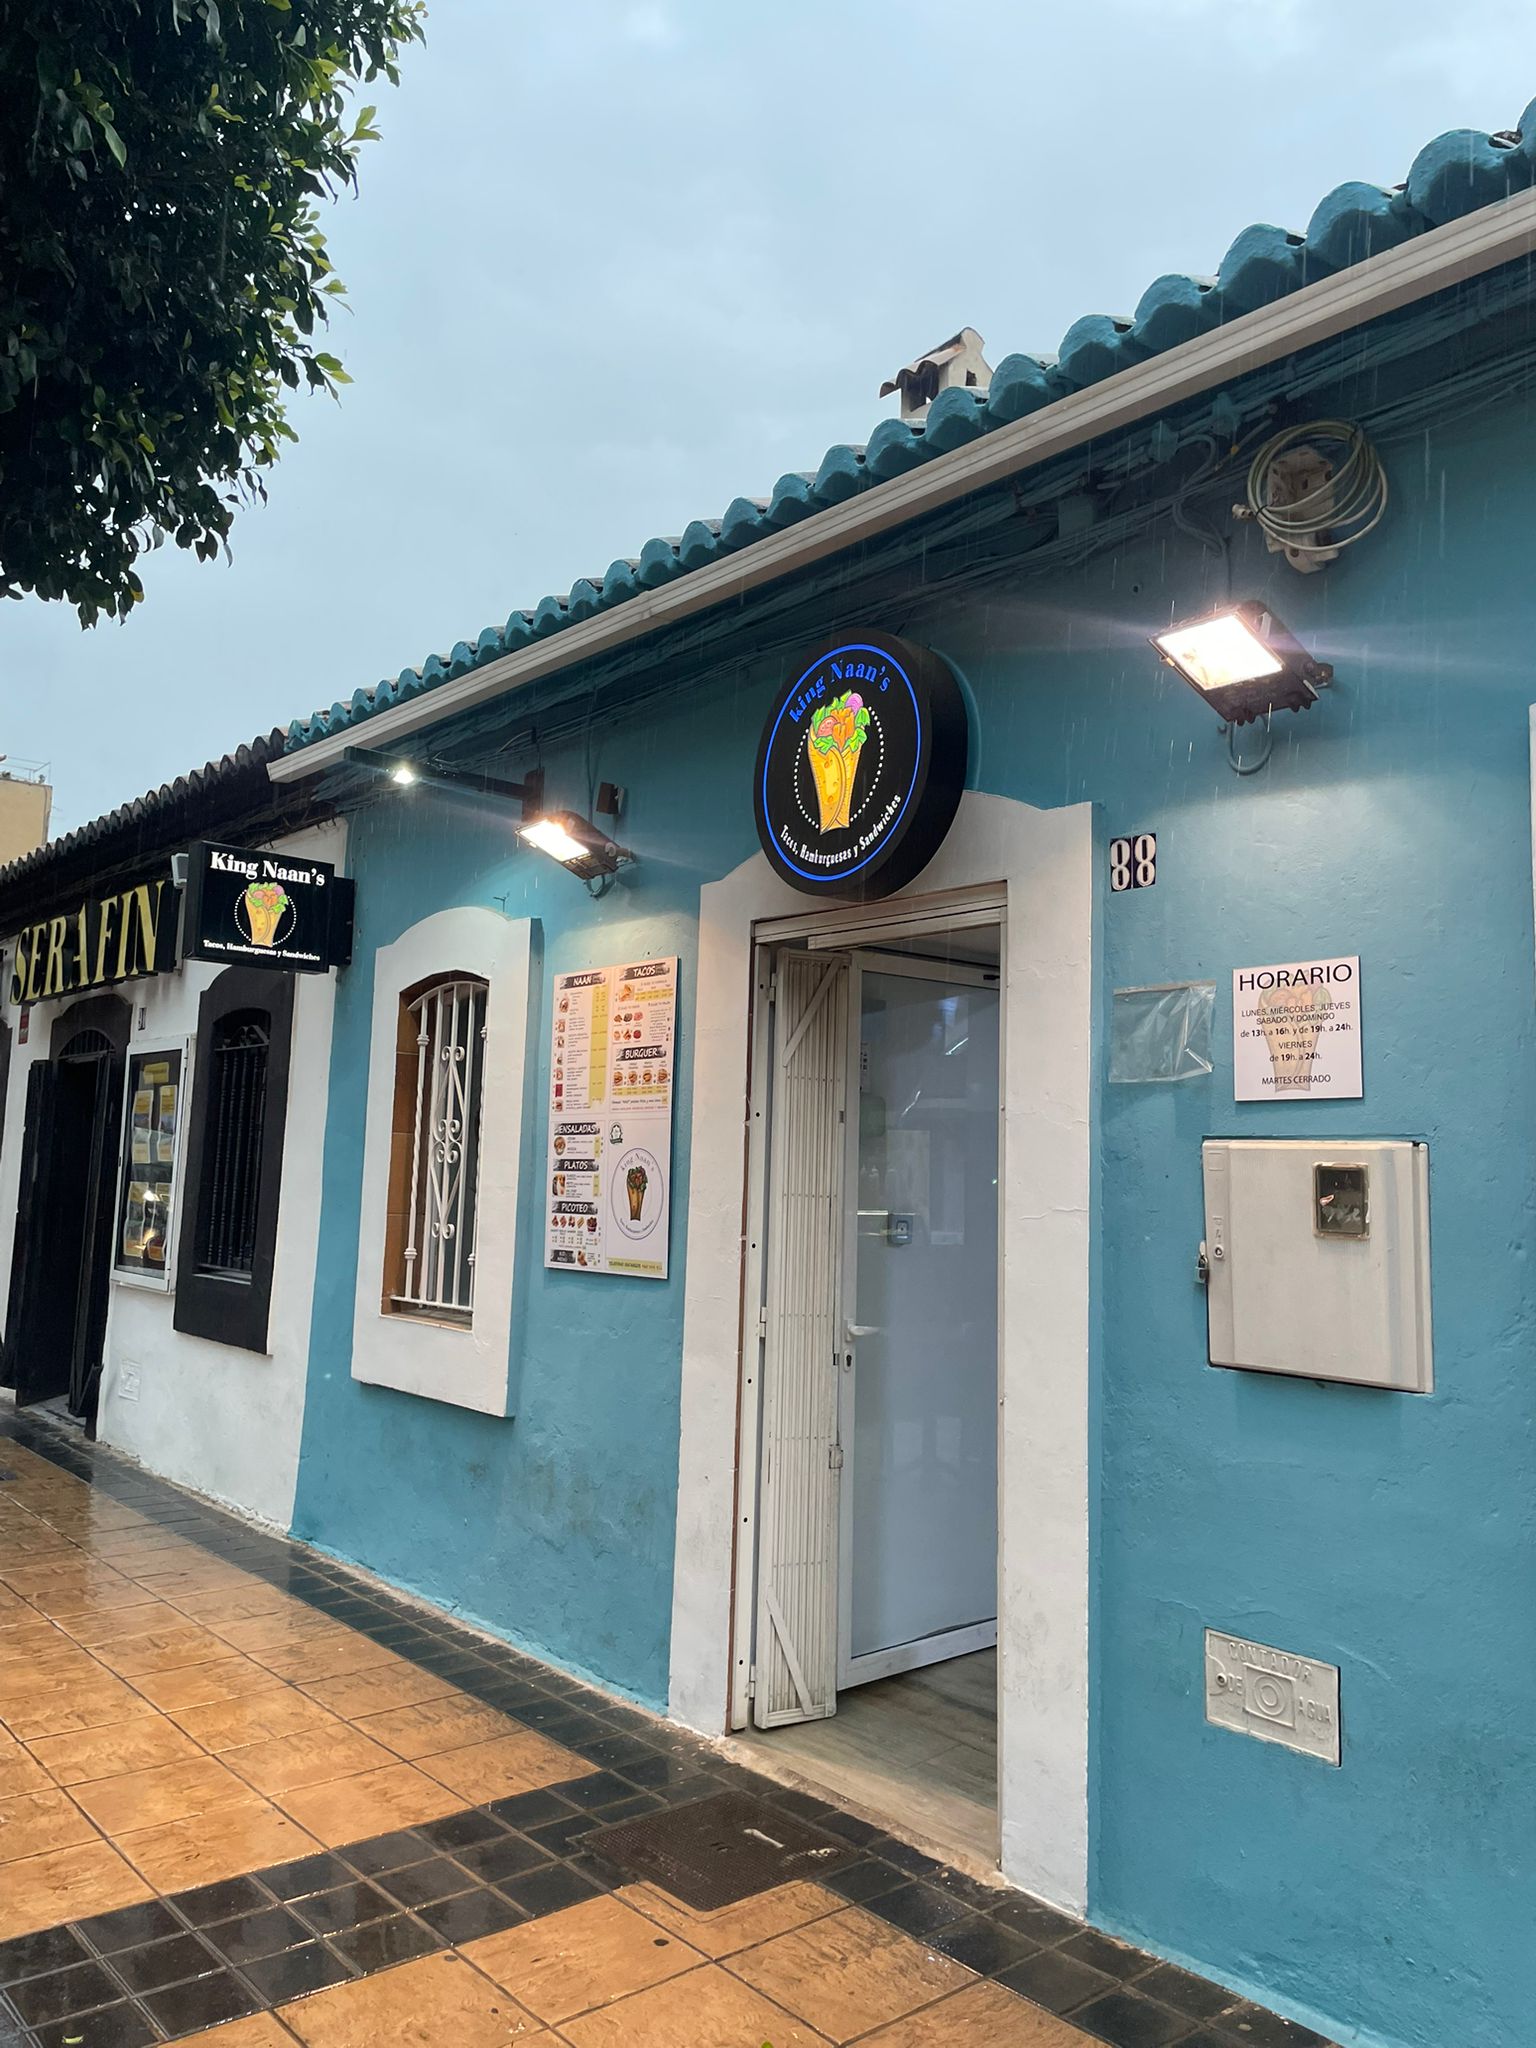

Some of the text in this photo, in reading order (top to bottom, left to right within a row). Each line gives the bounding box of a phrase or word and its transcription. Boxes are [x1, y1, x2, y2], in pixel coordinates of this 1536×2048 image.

[831, 660, 890, 691] Naan's
[800, 844, 851, 868] Hamburguesas
[853, 845, 859, 858] y
[859, 795, 901, 850] Sandwiches
[1110, 834, 1157, 891] 88
[210, 851, 325, 886] King Naan's
[10, 880, 165, 1005] SERAFIN
[203, 940, 225, 950] Tacos,
[226, 943, 276, 955] Hamburguesas
[282, 950, 320, 961] Sandwiches
[633, 966, 656, 977] TACOS
[573, 976, 592, 986] NAAN
[1239, 964, 1352, 991] HORARIO
[1319, 1001, 1351, 1011] JUEVES
[1296, 1012, 1335, 1023] DOMINGO
[1240, 1030, 1250, 1038] de
[1293, 1028, 1298, 1036] y
[1299, 1025, 1309, 1034] de
[1278, 1040, 1313, 1049] VIERNES
[625, 1048, 658, 1059] BURGUER
[1269, 1054, 1279, 1062] de
[1262, 1075, 1331, 1085] MARTES CERRADO
[559, 1124, 596, 1134] ENSALADAS
[563, 1161, 588, 1170] PLATOS
[561, 1203, 589, 1213] PICOTEO
[1228, 1642, 1313, 1683] CONTADOR
